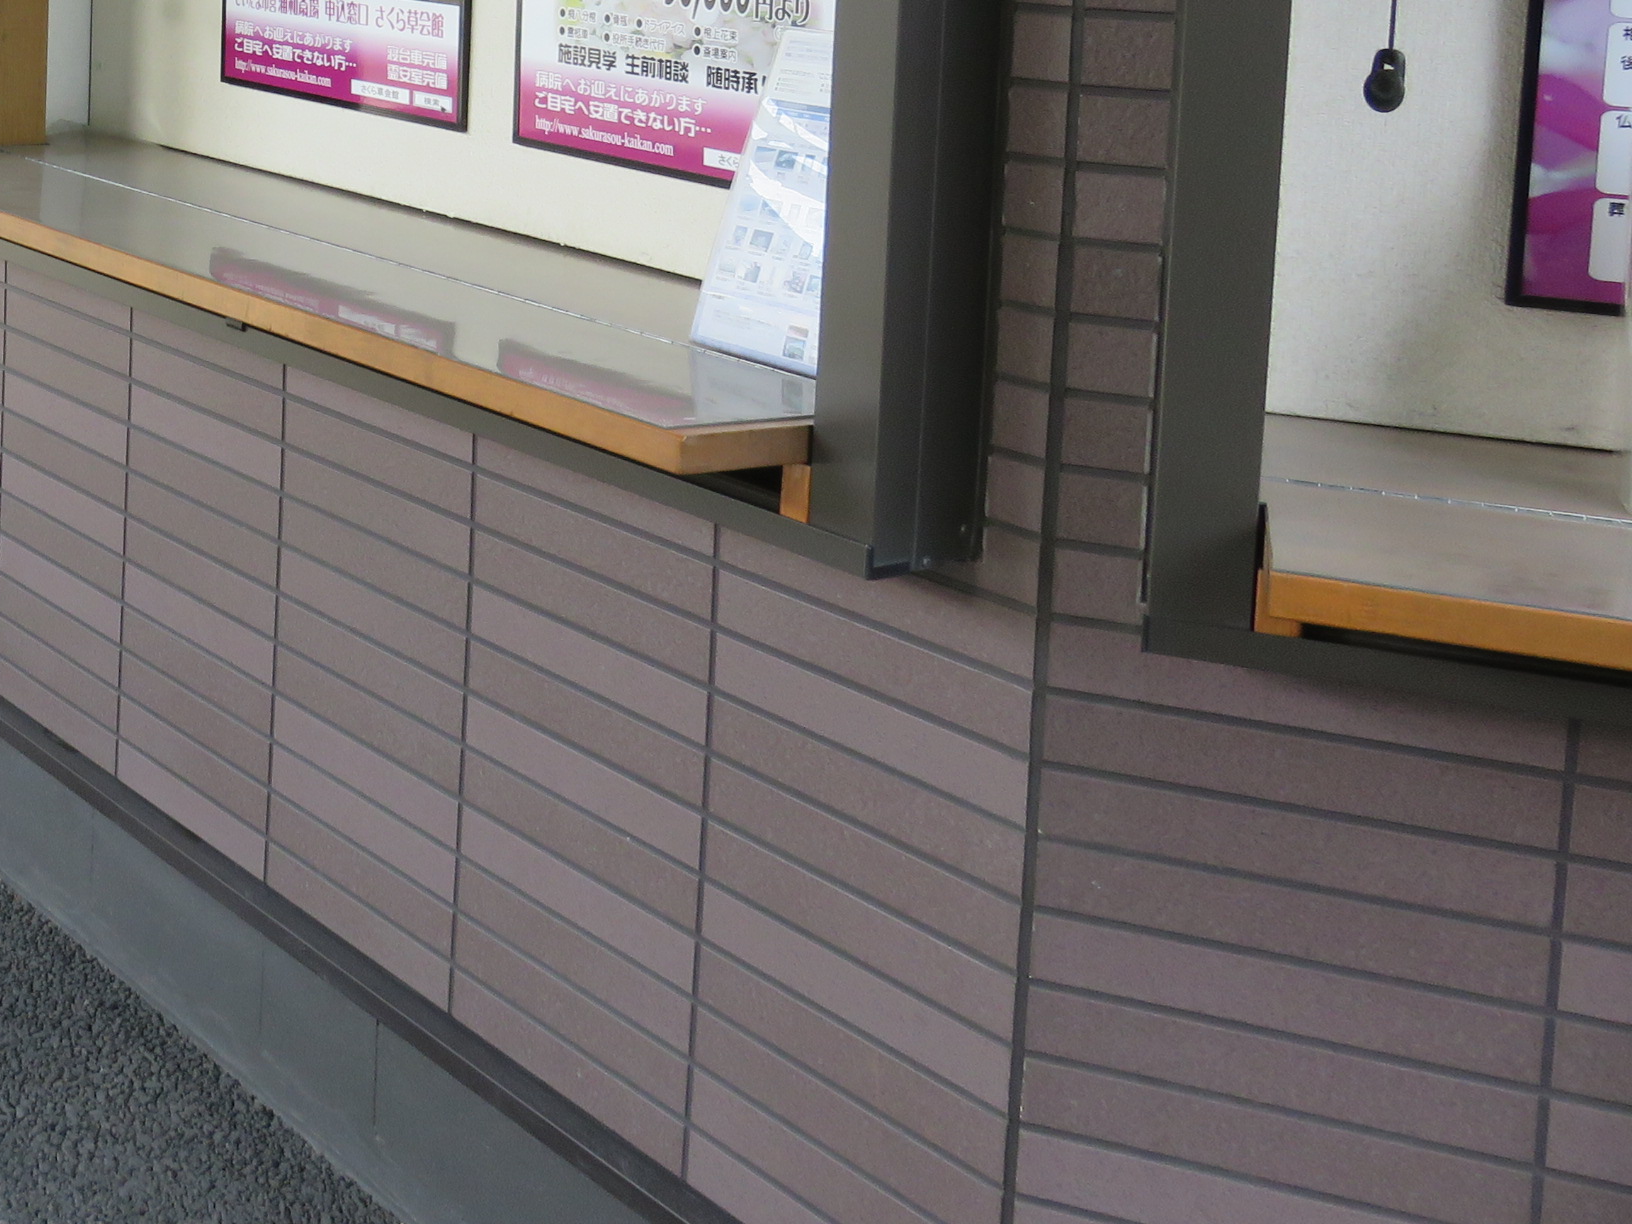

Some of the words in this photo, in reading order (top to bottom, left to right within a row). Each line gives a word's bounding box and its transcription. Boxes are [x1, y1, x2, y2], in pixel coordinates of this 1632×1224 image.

[234, 19, 353, 53] 病院へお迎えにあがります
[375, 6, 445, 39] さくら草会館
[386, 45, 448, 70] 寝台車完備
[557, 42, 617, 70] 施設見学
[624, 53, 690, 84] 生前相談
[360, 84, 400, 100] さくら草会館
[386, 63, 448, 90] 霊安室完備
[534, 70, 708, 115] 病院へお迎えにあがります
[534, 114, 675, 157] http://www.sakurasou-kaikan.com
